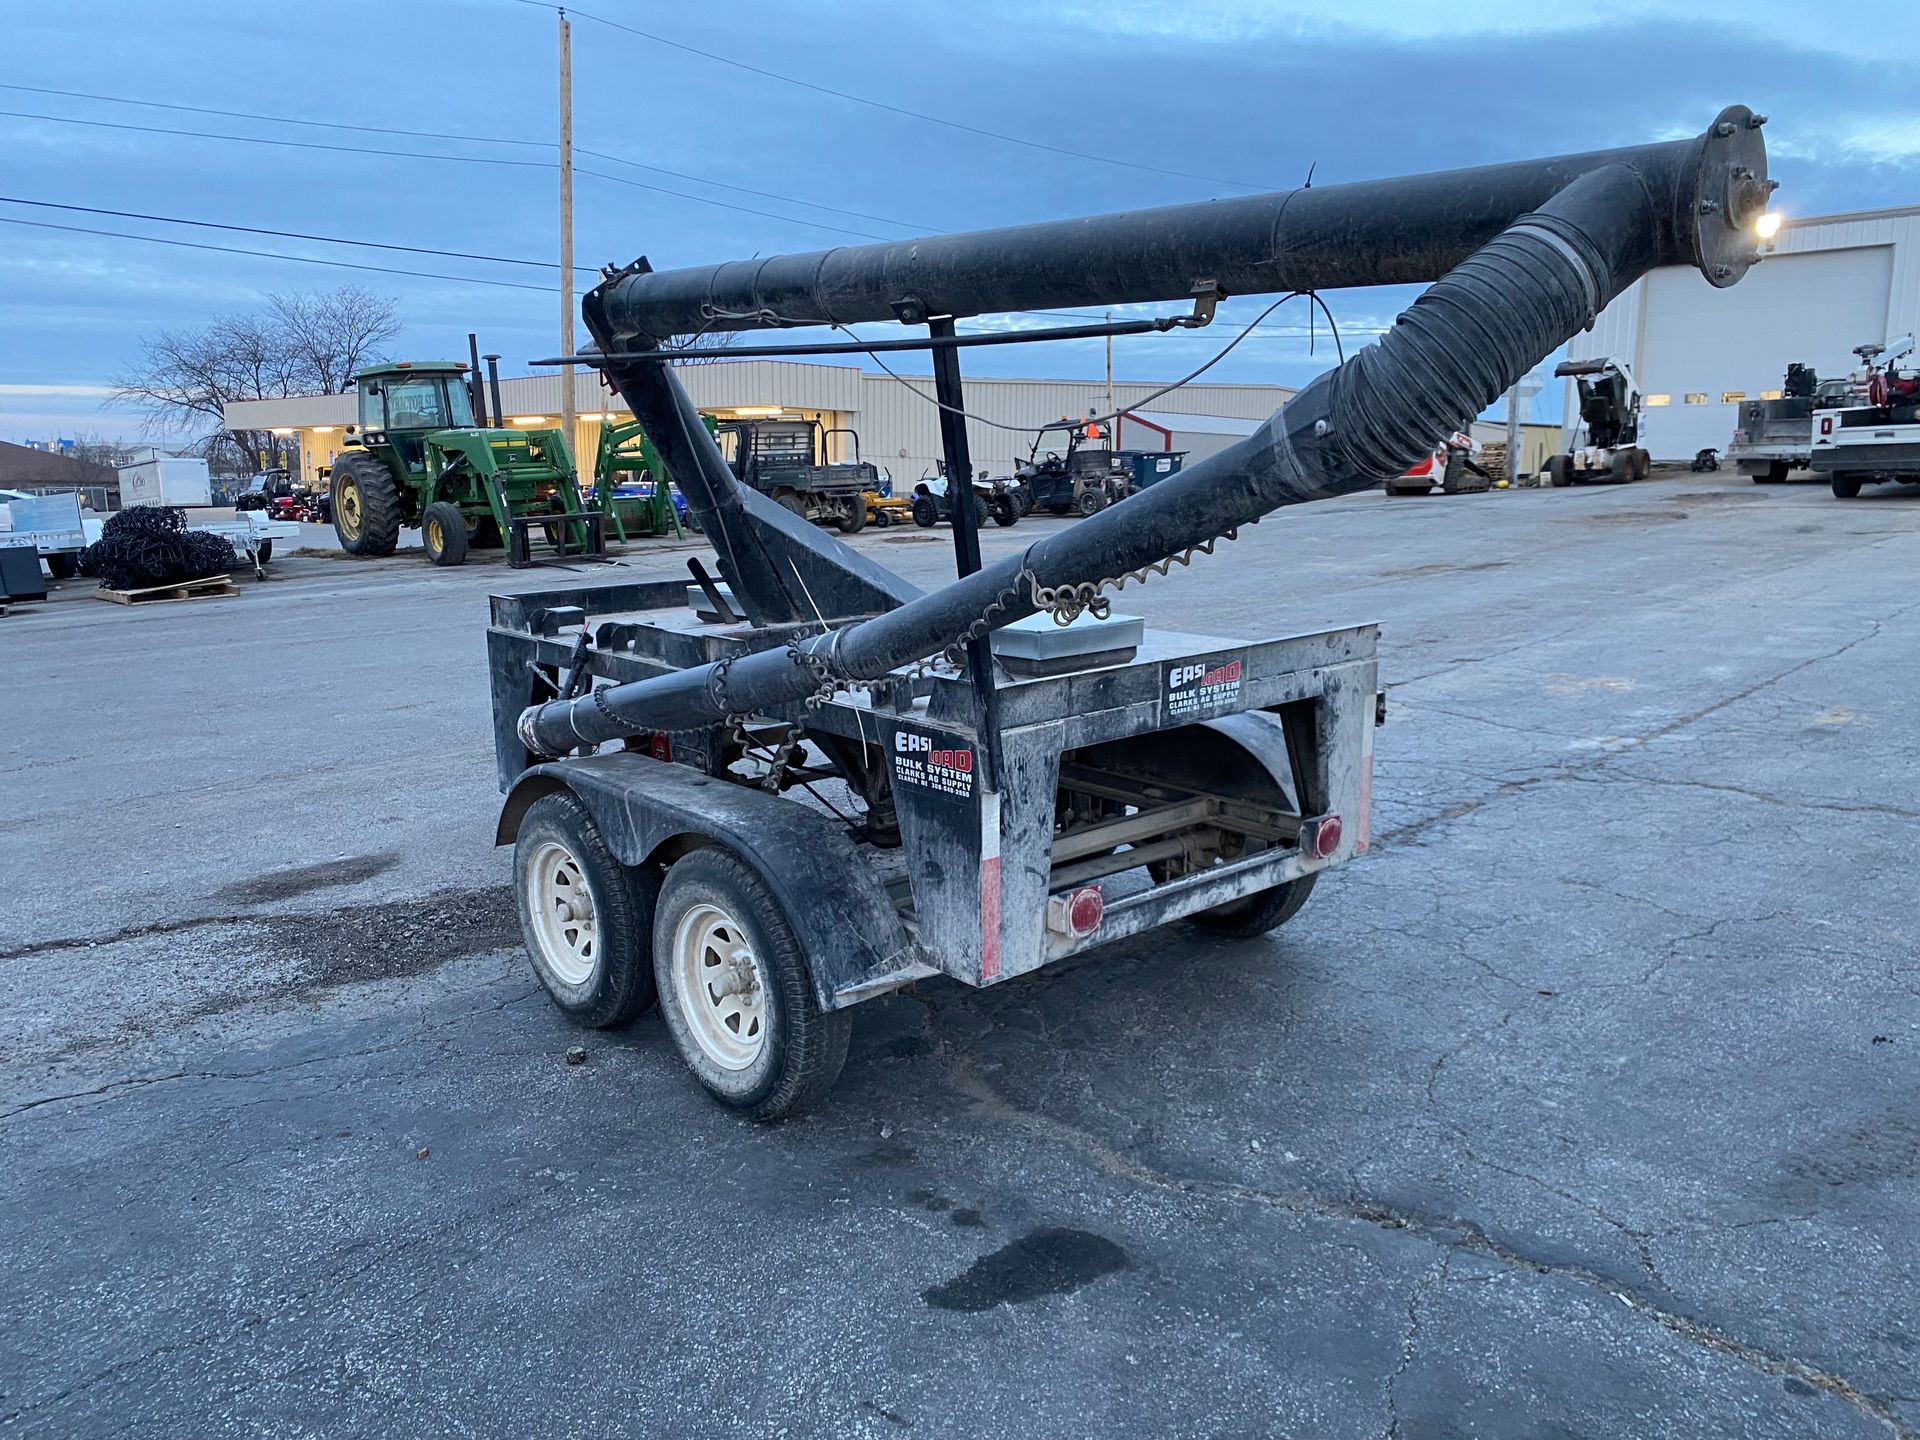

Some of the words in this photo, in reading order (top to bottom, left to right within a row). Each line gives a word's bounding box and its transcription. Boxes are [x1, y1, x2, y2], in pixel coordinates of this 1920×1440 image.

[391, 394, 423, 411] TRACTOR
[1169, 664, 1205, 688] EASI
[1201, 661, 1241, 686] LOAD
[1169, 690, 1196, 700] BULK
[1199, 682, 1240, 695] SYSTEM
[1169, 698, 1198, 709] CLARKS
[1213, 690, 1240, 700] SUPPLY
[895, 732, 932, 751] EASI
[928, 750, 972, 772] LOAD
[895, 757, 923, 770] BULK
[927, 765, 972, 782] SYSTEM
[896, 767, 926, 779] CLARKS
[941, 778, 971, 791] SUPPLY
